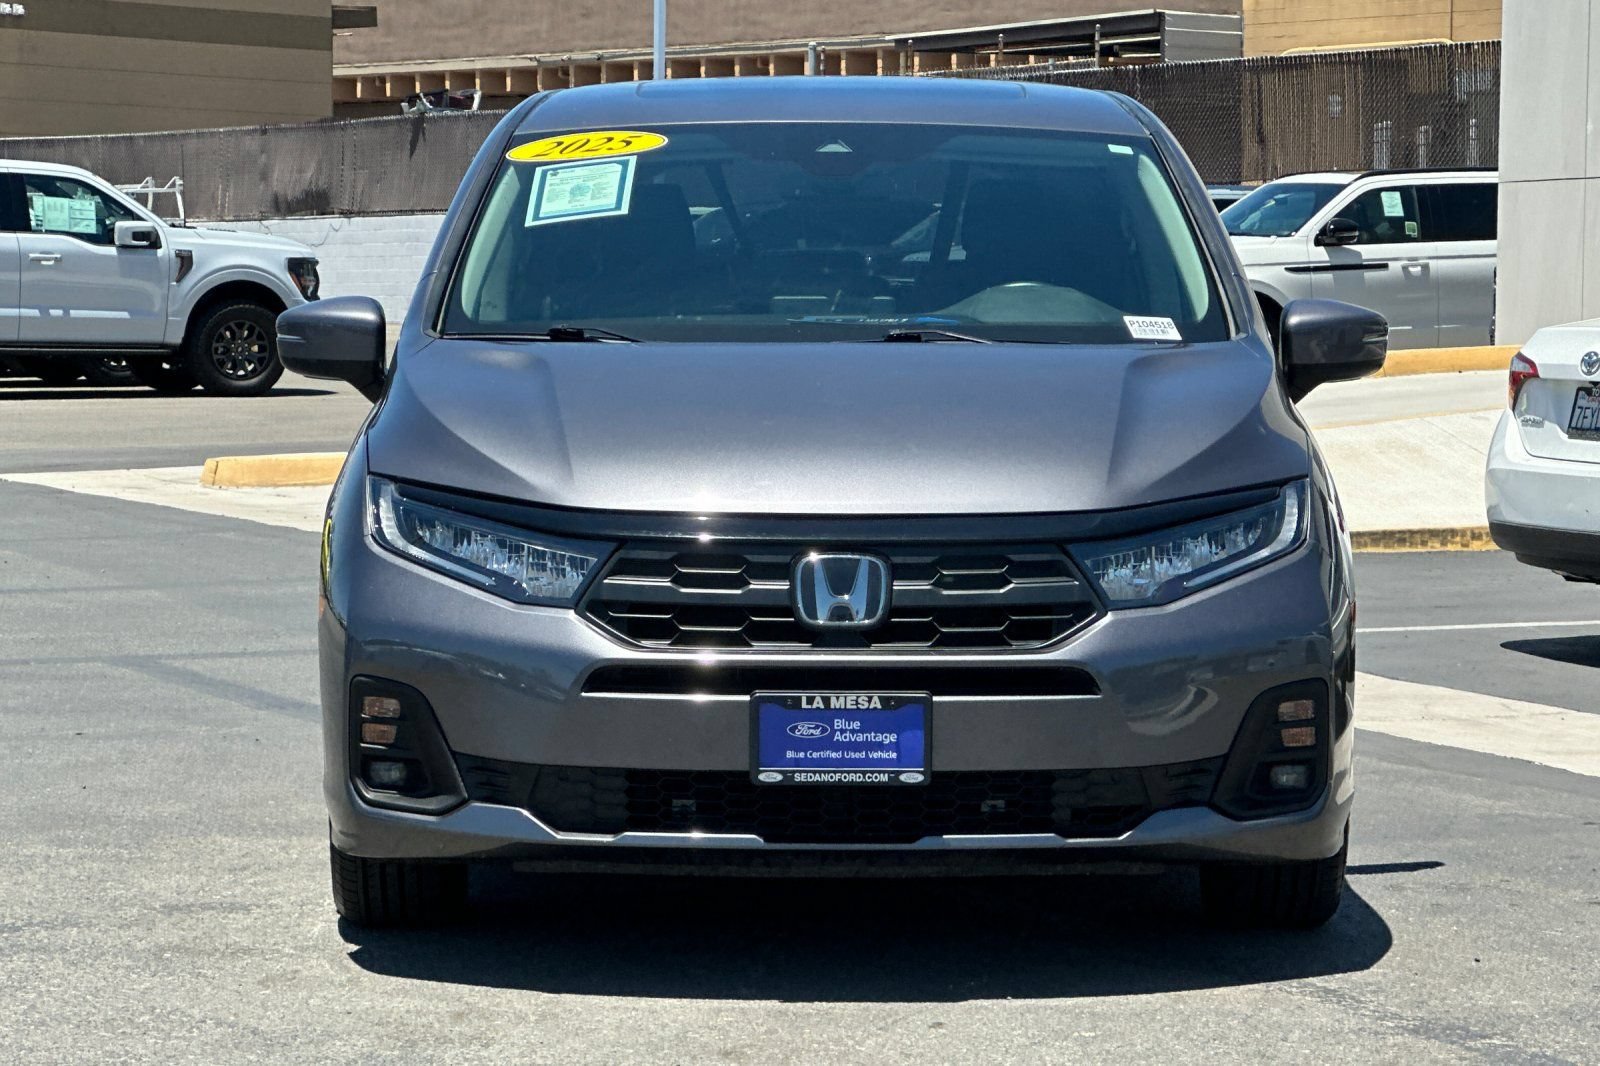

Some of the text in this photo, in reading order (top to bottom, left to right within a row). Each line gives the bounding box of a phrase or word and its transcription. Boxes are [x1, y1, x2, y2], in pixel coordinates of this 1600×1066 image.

[531, 135, 643, 158] 2025
[1129, 320, 1175, 330] P104518
[1575, 406, 1600, 430] 7FY
[801, 695, 882, 709] LA MESA
[795, 723, 822, 736] Ford
[833, 718, 861, 730] Blue
[833, 731, 897, 744] Advantage
[786, 750, 897, 759] Blue Certified Used Vehicle
[794, 772, 889, 782] SEDANOFORD.COM
